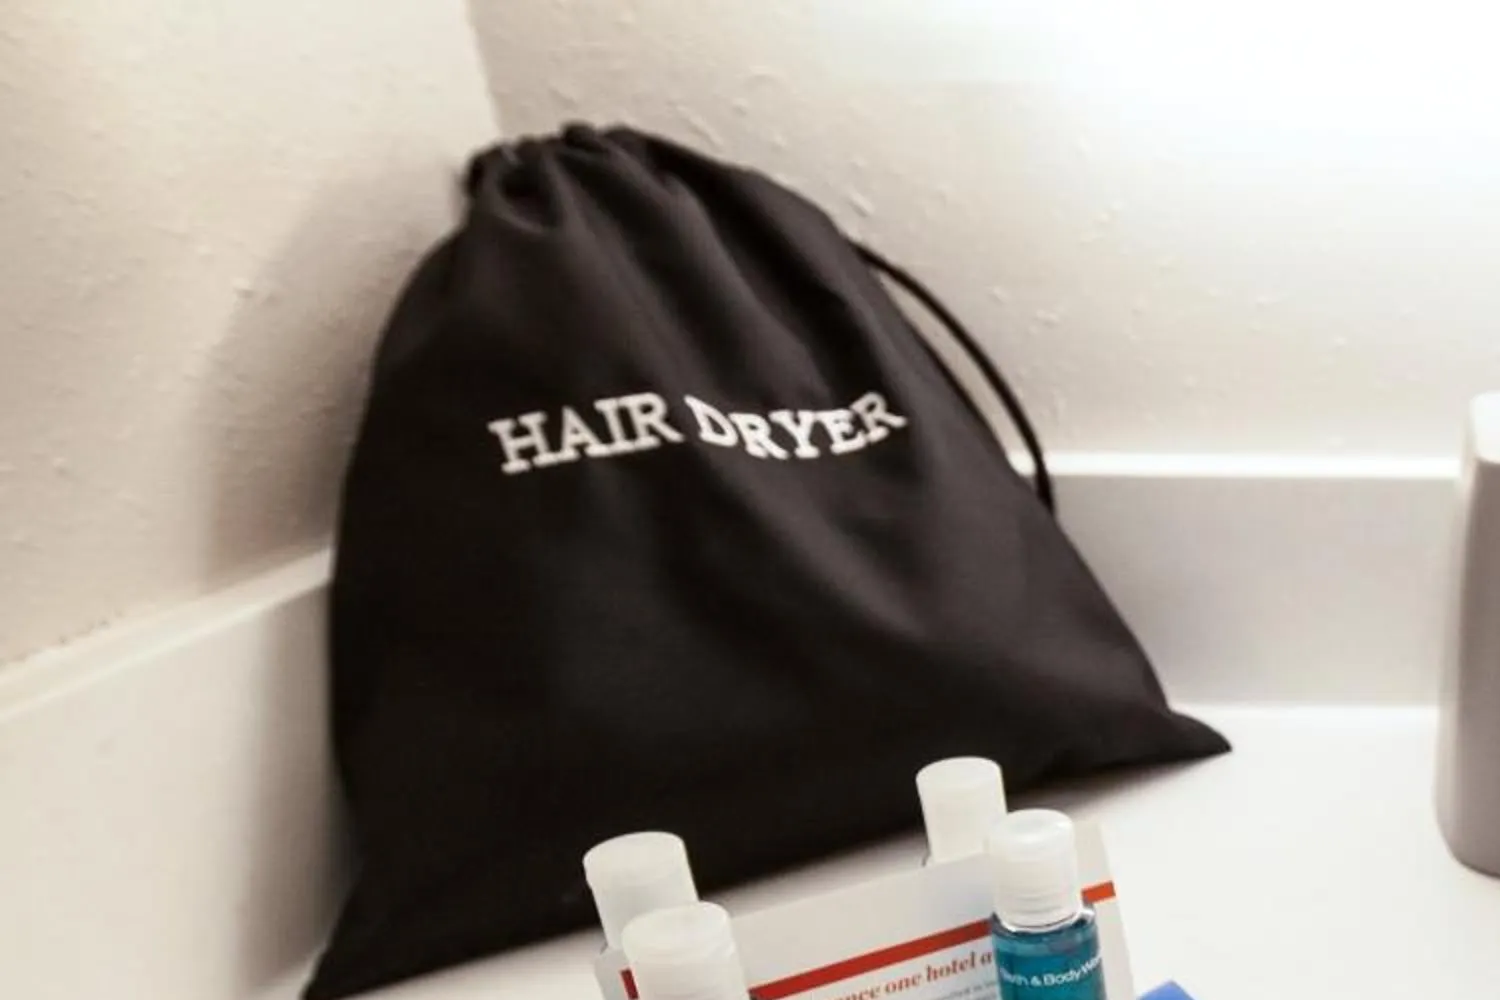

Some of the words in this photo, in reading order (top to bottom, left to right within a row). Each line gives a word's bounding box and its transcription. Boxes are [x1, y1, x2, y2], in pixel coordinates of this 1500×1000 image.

[487, 392, 684, 473] HAIR
[685, 391, 907, 459] DRYER
[884, 971, 924, 995] one
[925, 951, 977, 984] hotel
